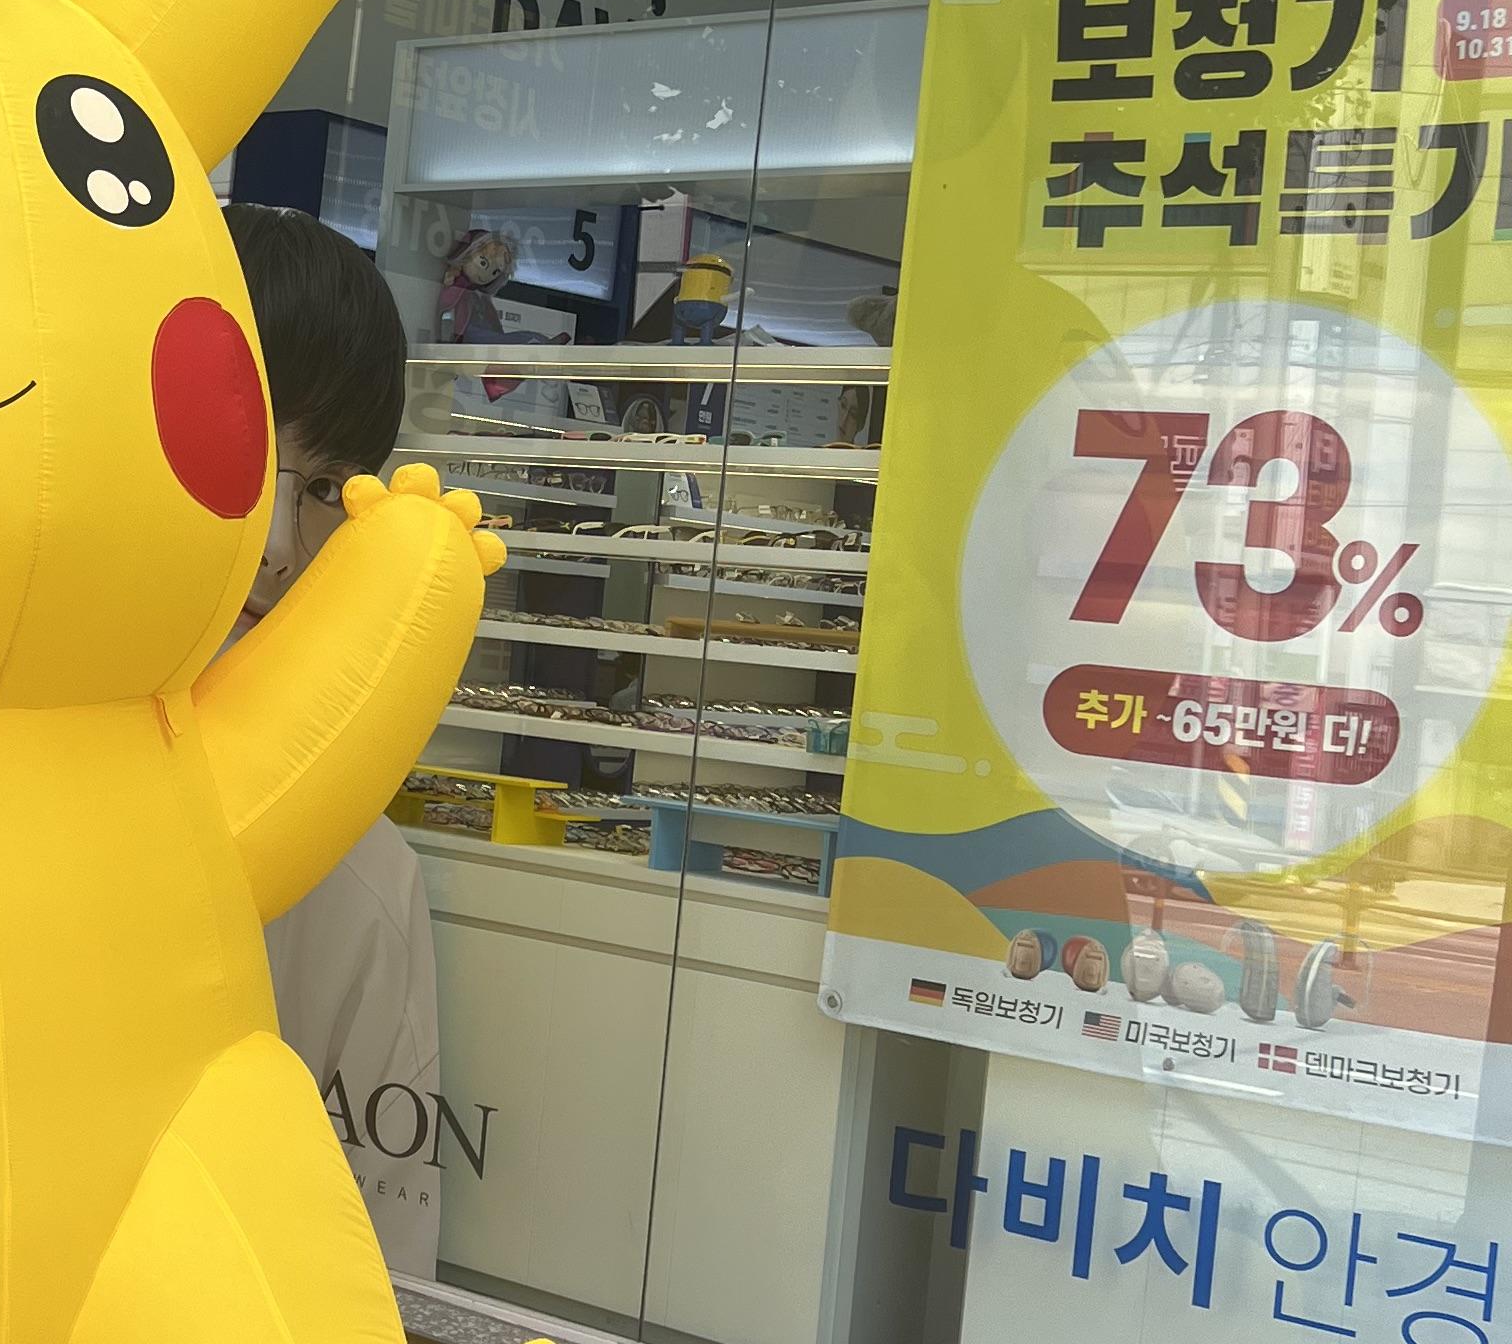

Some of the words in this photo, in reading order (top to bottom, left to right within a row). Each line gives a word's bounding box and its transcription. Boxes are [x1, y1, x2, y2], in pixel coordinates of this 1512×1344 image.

[1456, 8, 1507, 31] 9.18
[568, 209, 598, 271] 5
[1069, 409, 1424, 642] 73%
[1076, 689, 1147, 734] 추가
[1322, 714, 1374, 758] 더!
[951, 986, 1064, 1030] 독일보청기
[1124, 1020, 1236, 1064] 미국보청기
[1304, 1051, 1461, 1101] 덴마크보청기
[888, 1125, 1223, 1310] 다비치
